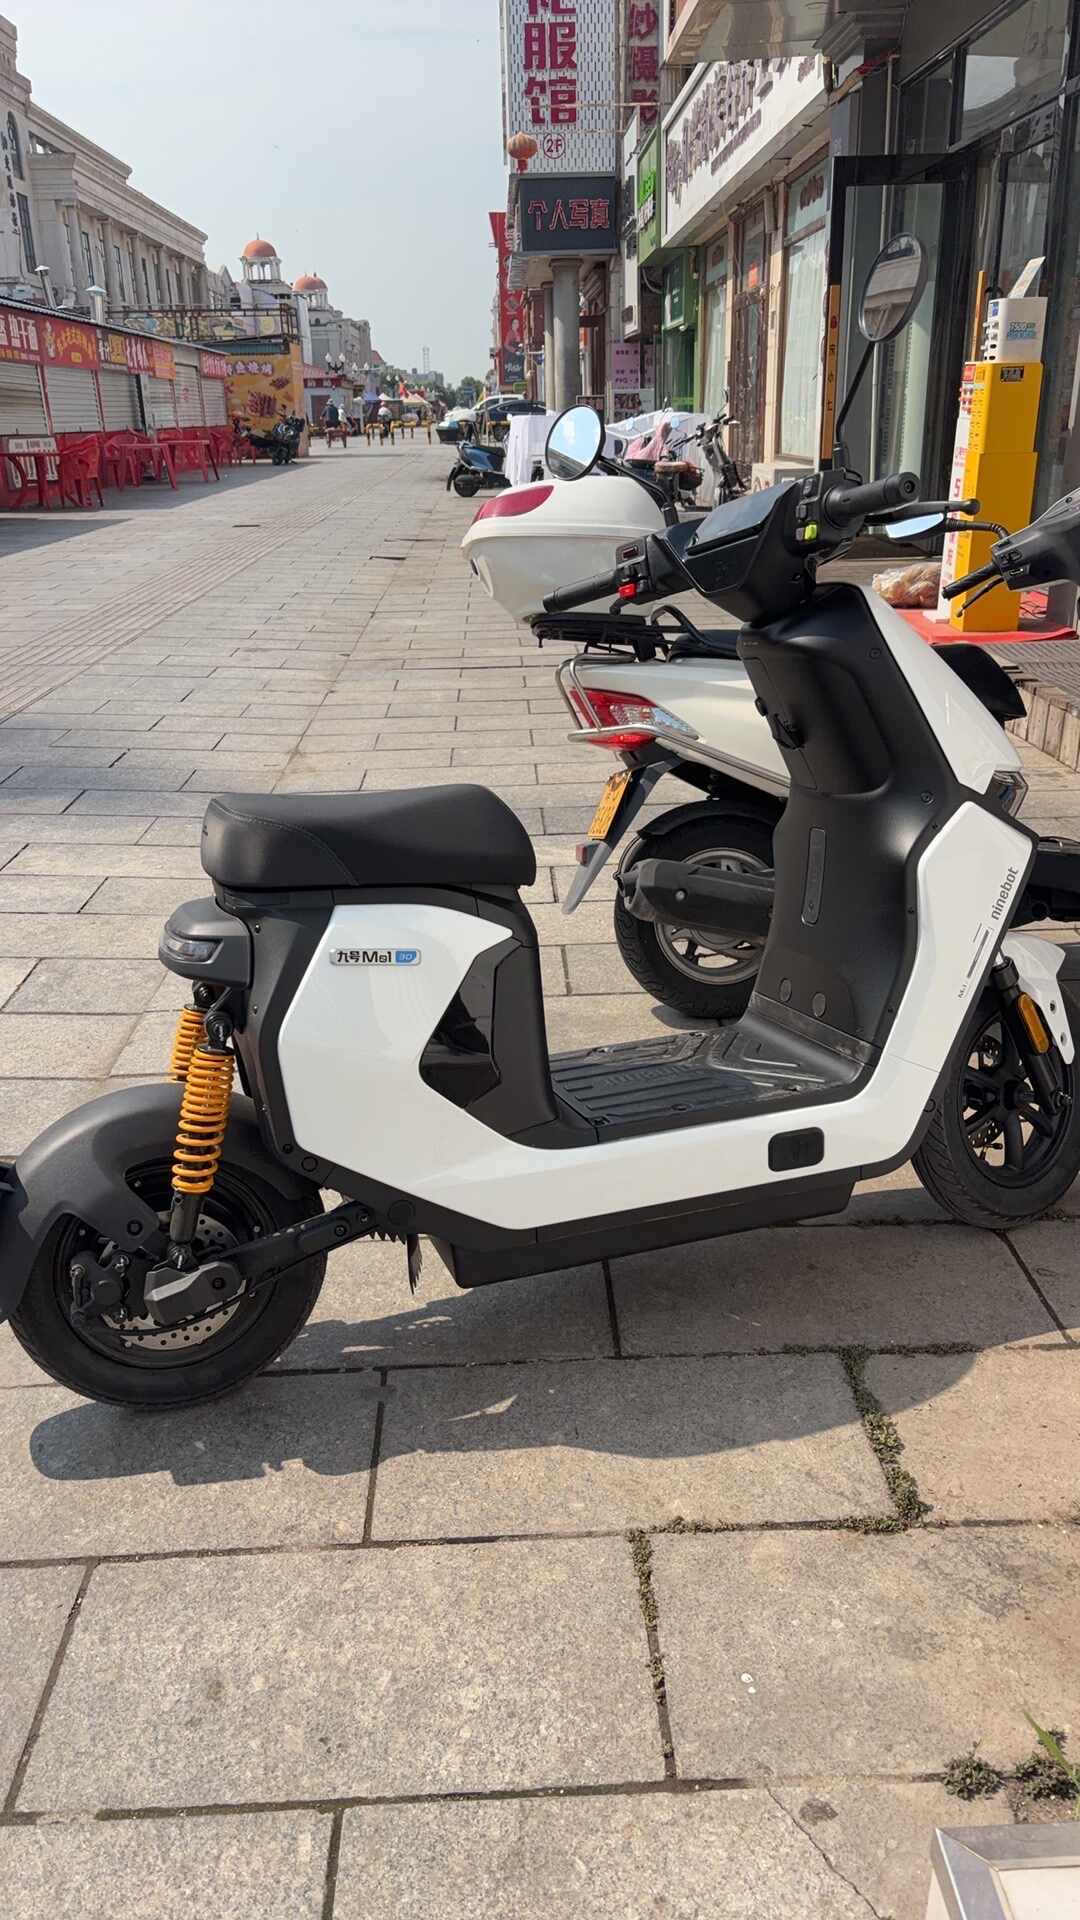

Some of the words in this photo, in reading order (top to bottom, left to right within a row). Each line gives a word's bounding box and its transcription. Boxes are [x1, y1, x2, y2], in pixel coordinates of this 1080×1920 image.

[527, 199, 610, 231] 个人写真
[991, 866, 1019, 921] ninebot
